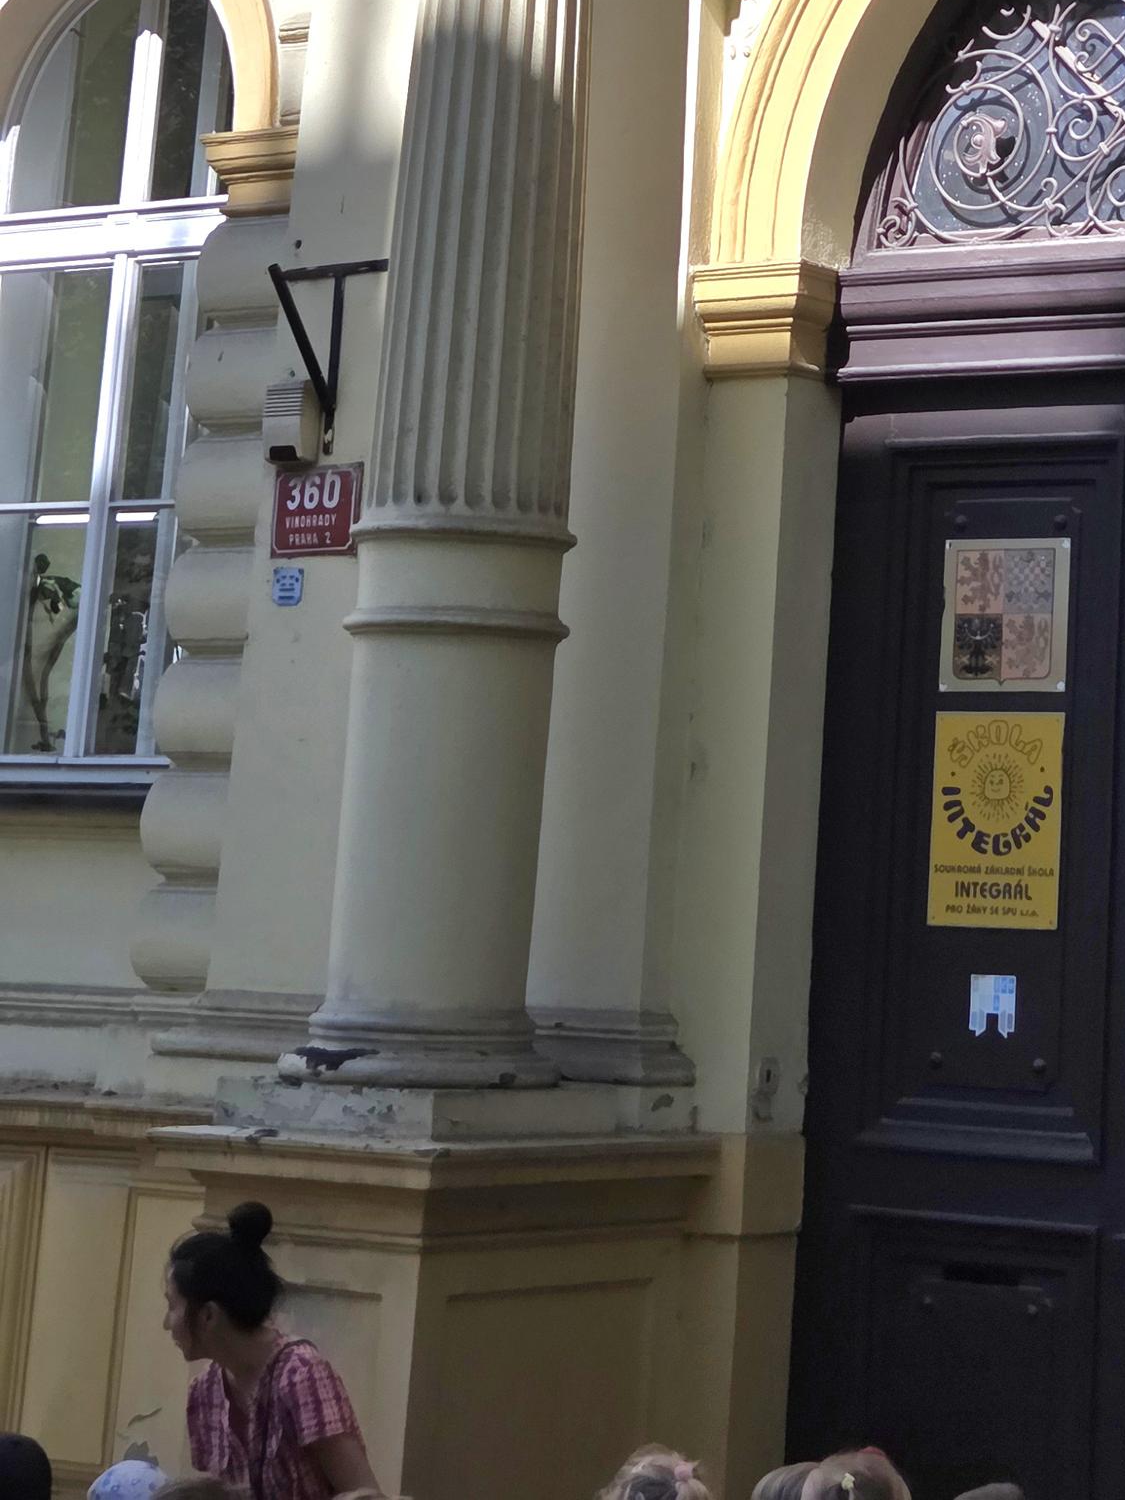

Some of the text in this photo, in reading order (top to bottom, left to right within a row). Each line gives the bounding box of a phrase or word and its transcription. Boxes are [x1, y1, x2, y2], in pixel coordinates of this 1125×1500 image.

[286, 470, 342, 511] 360
[285, 513, 337, 529] VINOHRADY
[289, 531, 332, 546] PRAHA 2
[947, 719, 1044, 768] ŠKOLA
[941, 785, 1054, 856] INTEGRÁL
[934, 863, 1055, 877] SOUKROMÁ ZÁKLADNÍ ŠKOLA
[954, 878, 1033, 901] INTEGRÁL
[945, 904, 963, 914] PRO
[966, 903, 987, 915] ŽÁKY
[989, 905, 999, 916] SE
[1002, 906, 1017, 916] SPU
